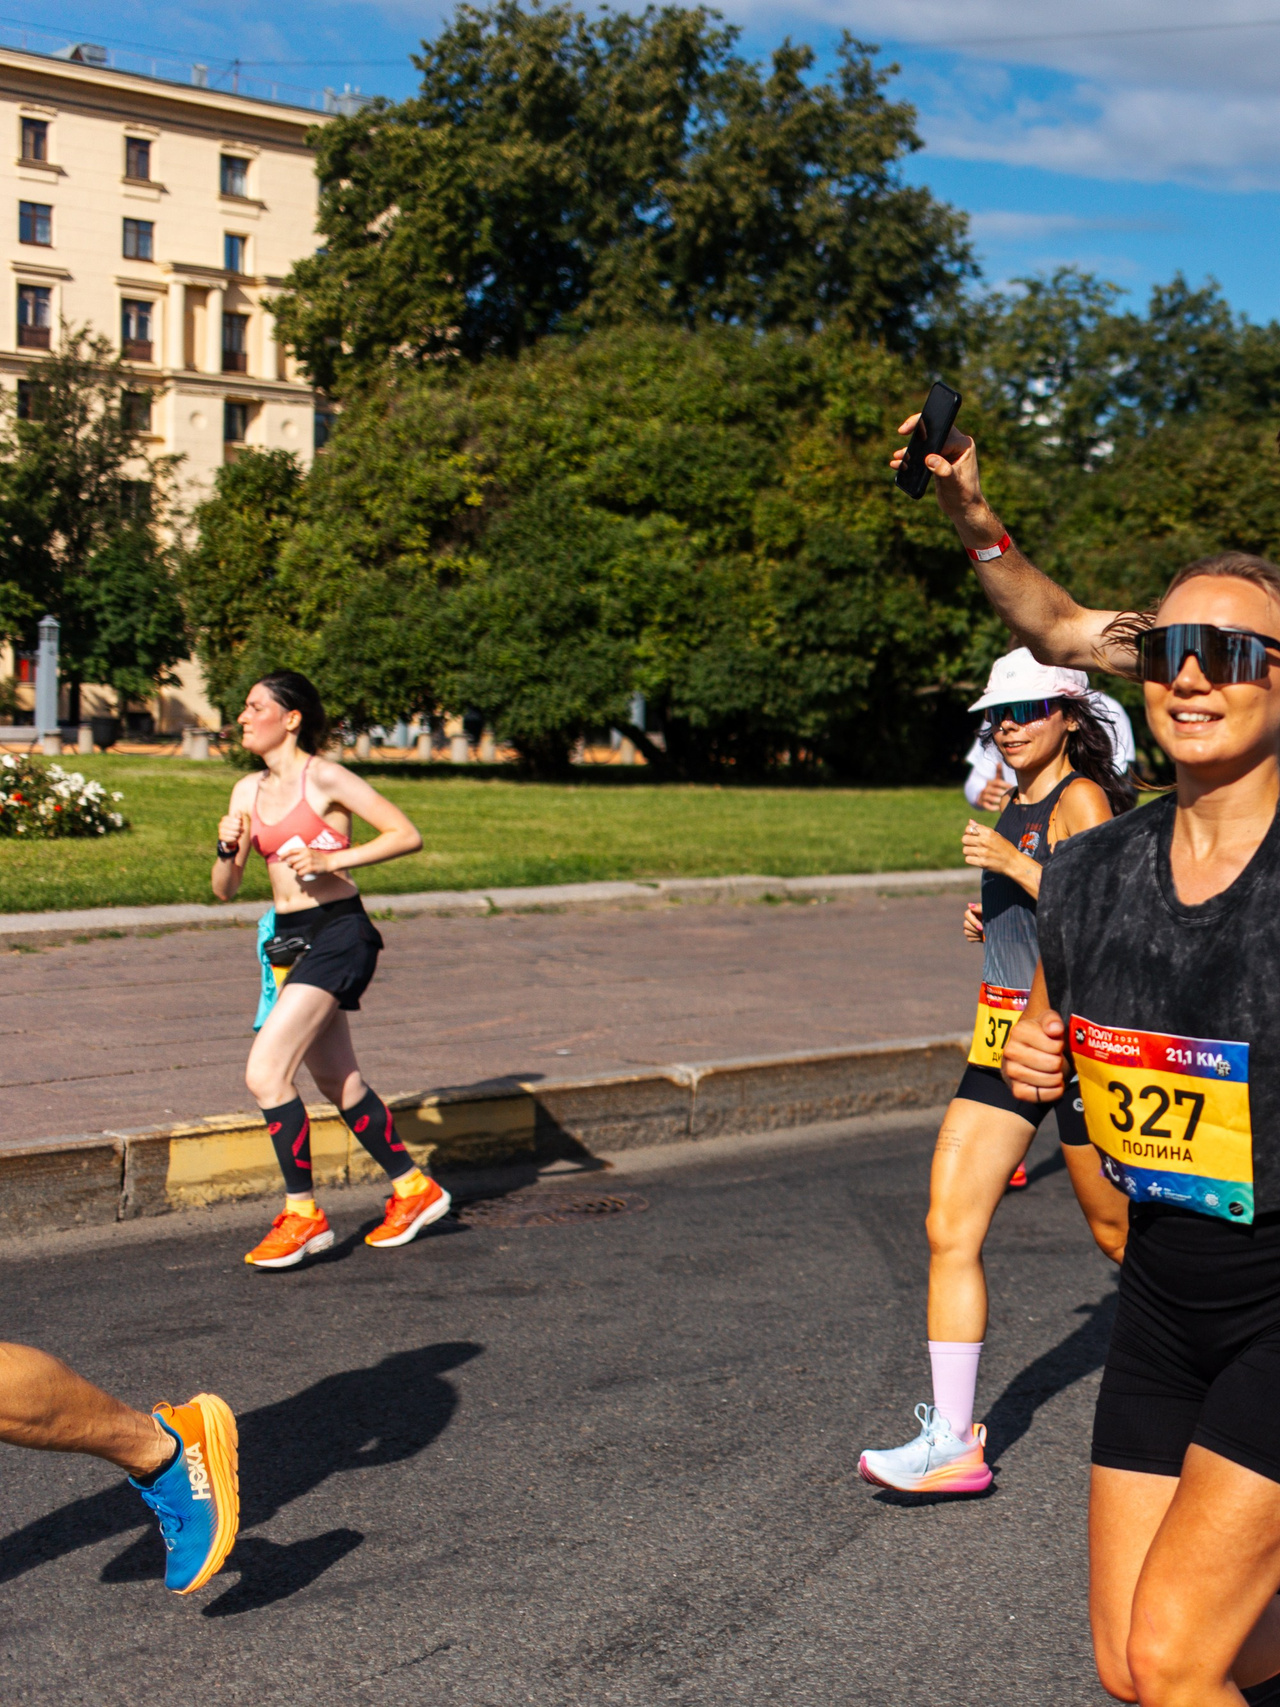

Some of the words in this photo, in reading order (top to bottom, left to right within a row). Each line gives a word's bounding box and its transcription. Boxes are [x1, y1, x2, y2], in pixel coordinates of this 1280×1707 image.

[985, 1016, 1013, 1049] 37
[1087, 1026, 1113, 1042] ПОЛУ
[1114, 1035, 1140, 1044] 2026
[1087, 1037, 1141, 1056] МАРАФОН
[1165, 1047, 1193, 1067] 21,1
[1107, 1080, 1206, 1142] 327
[1121, 1138, 1194, 1163] ПОЛИНА
[184, 1441, 212, 1501] HOKA
